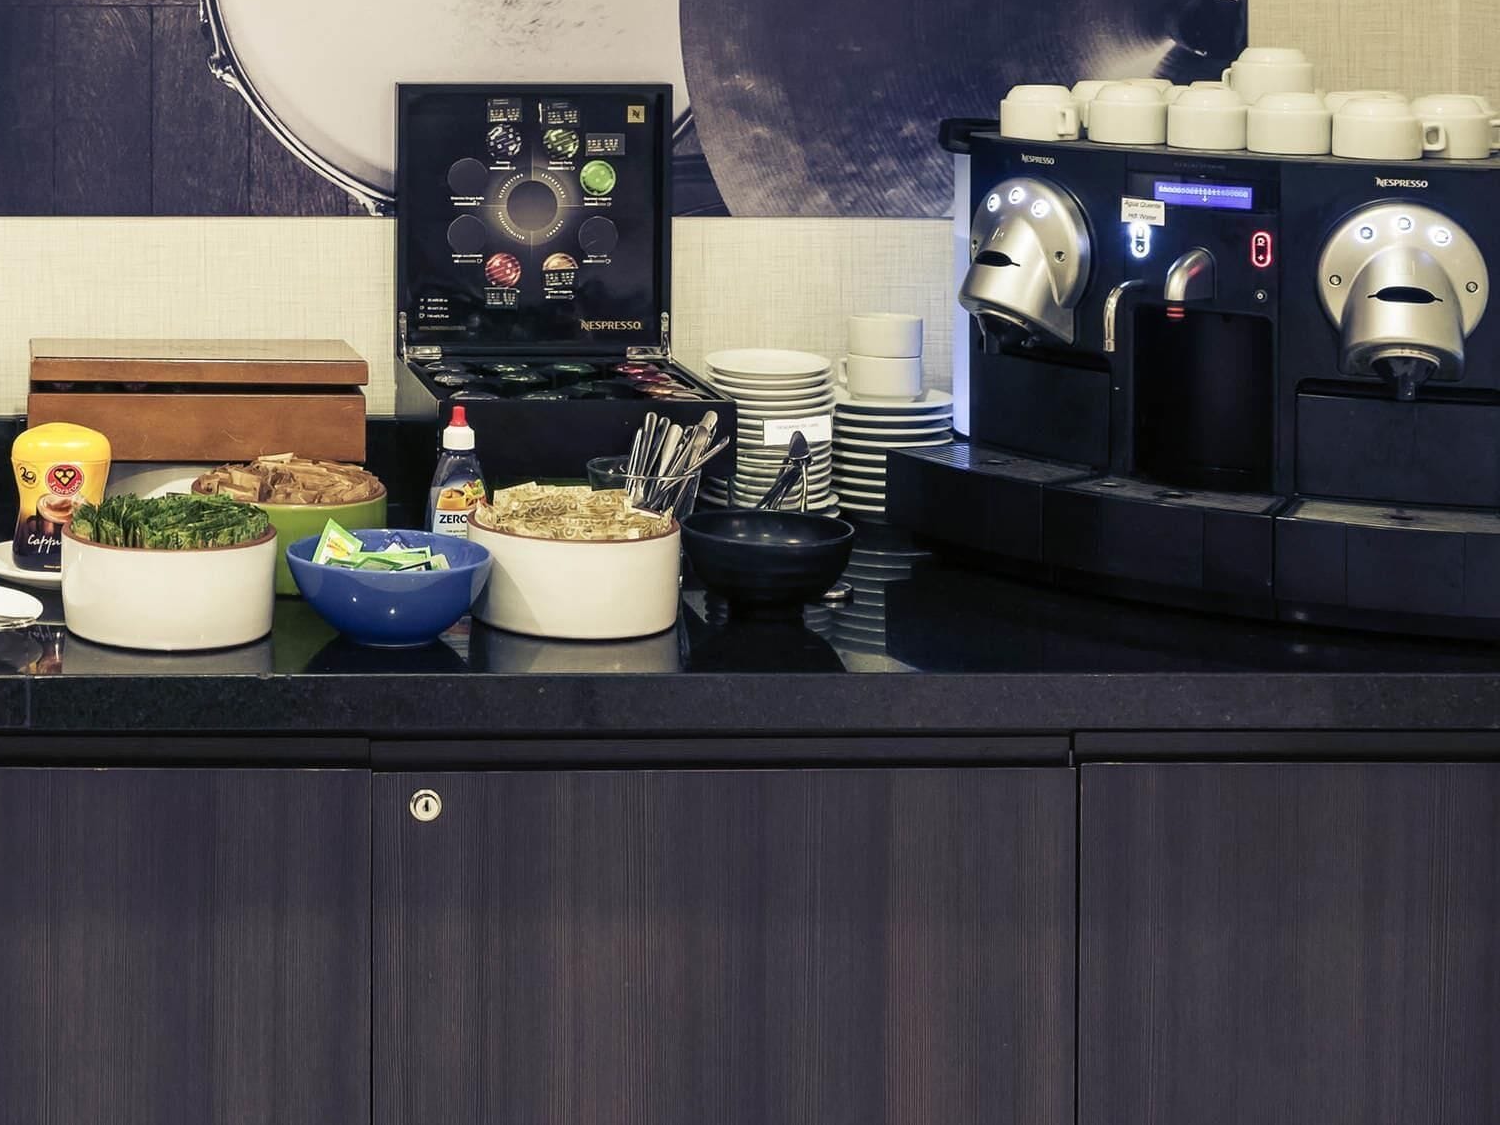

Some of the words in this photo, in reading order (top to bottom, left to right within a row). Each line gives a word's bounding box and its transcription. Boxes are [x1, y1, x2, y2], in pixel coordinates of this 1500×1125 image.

[1021, 153, 1055, 165] NESPRESSO
[1375, 176, 1429, 188] NESPRESSO
[580, 319, 641, 331] NESPRESSO
[439, 514, 468, 524] ZERO
